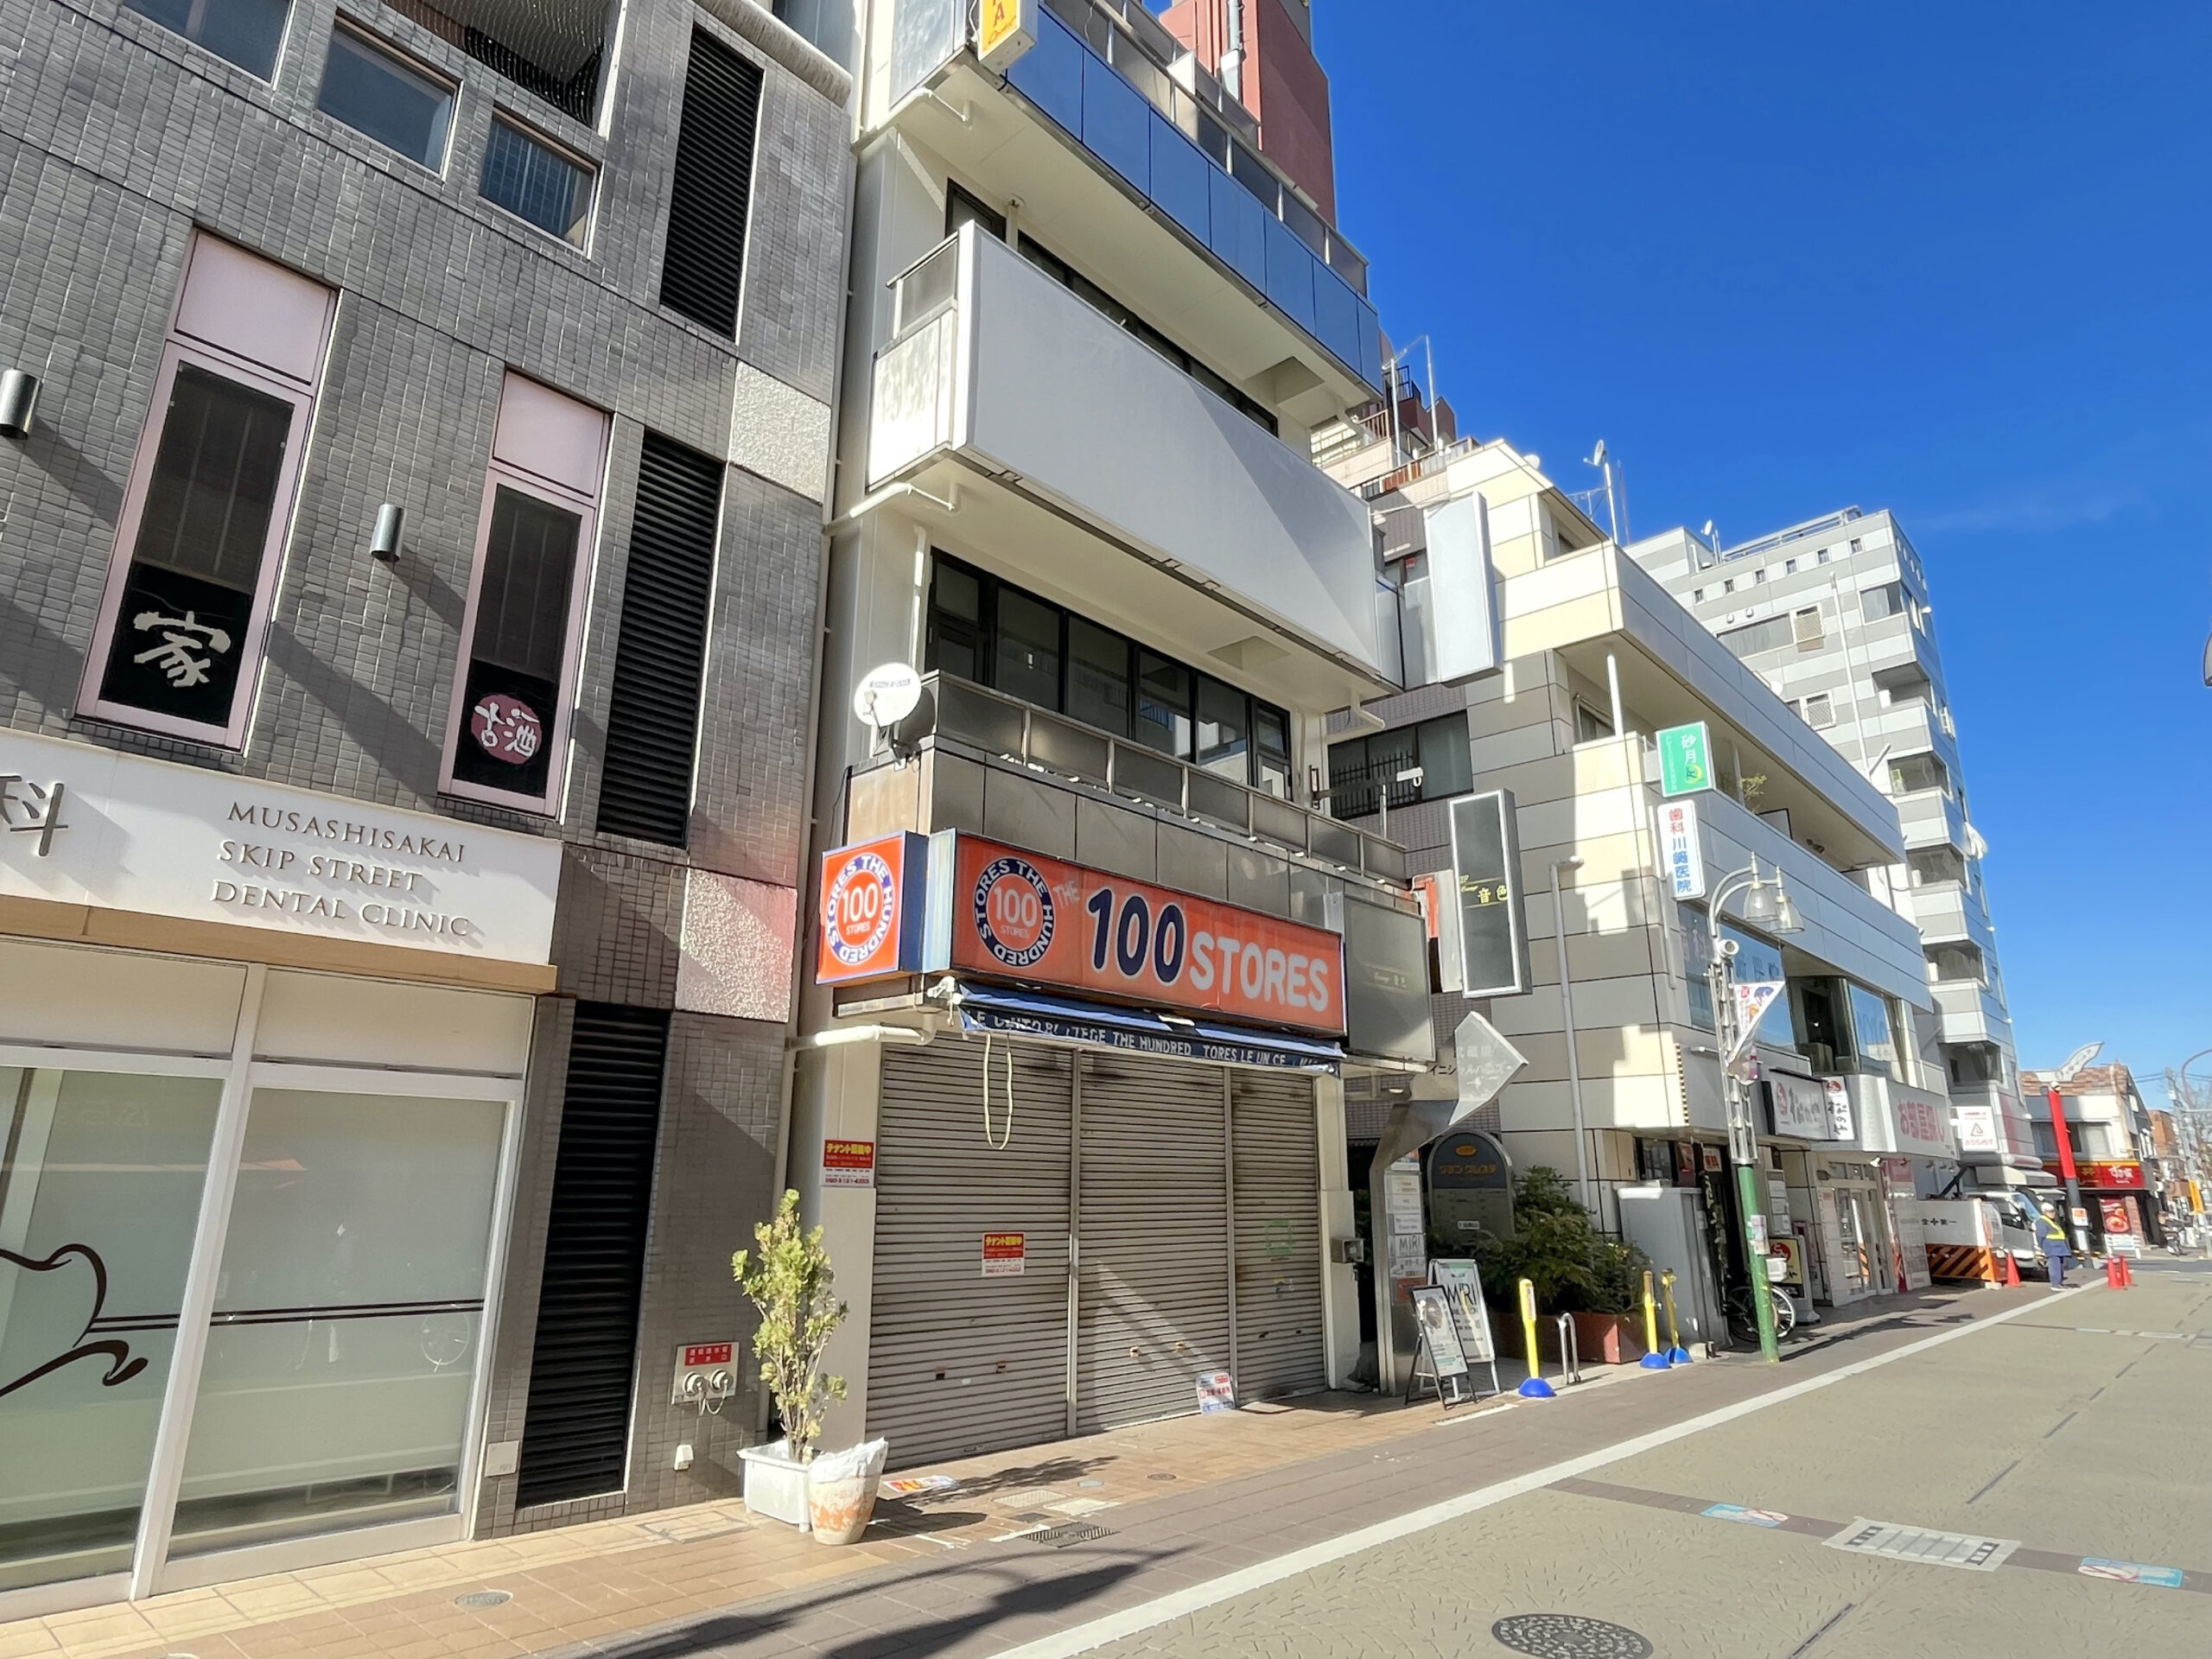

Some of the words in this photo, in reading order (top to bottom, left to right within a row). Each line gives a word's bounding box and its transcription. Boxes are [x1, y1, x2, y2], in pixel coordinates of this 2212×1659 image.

[227, 801, 465, 862] MUSASHISAKAI
[217, 840, 296, 870] SKIP
[307, 855, 422, 892] STREET
[861, 855, 888, 883] THE
[1016, 861, 1048, 898] THE
[209, 880, 346, 919] DENTAL
[359, 903, 469, 937] CLINIC
[842, 883, 878, 925] 100
[995, 887, 1037, 927] 100
[1052, 880, 1080, 908] THE
[1086, 887, 1186, 986] 100
[1189, 931, 1330, 1013] STORES
[1113, 1032, 1135, 1048] THE
[1140, 1037, 1192, 1056] HUNDRED
